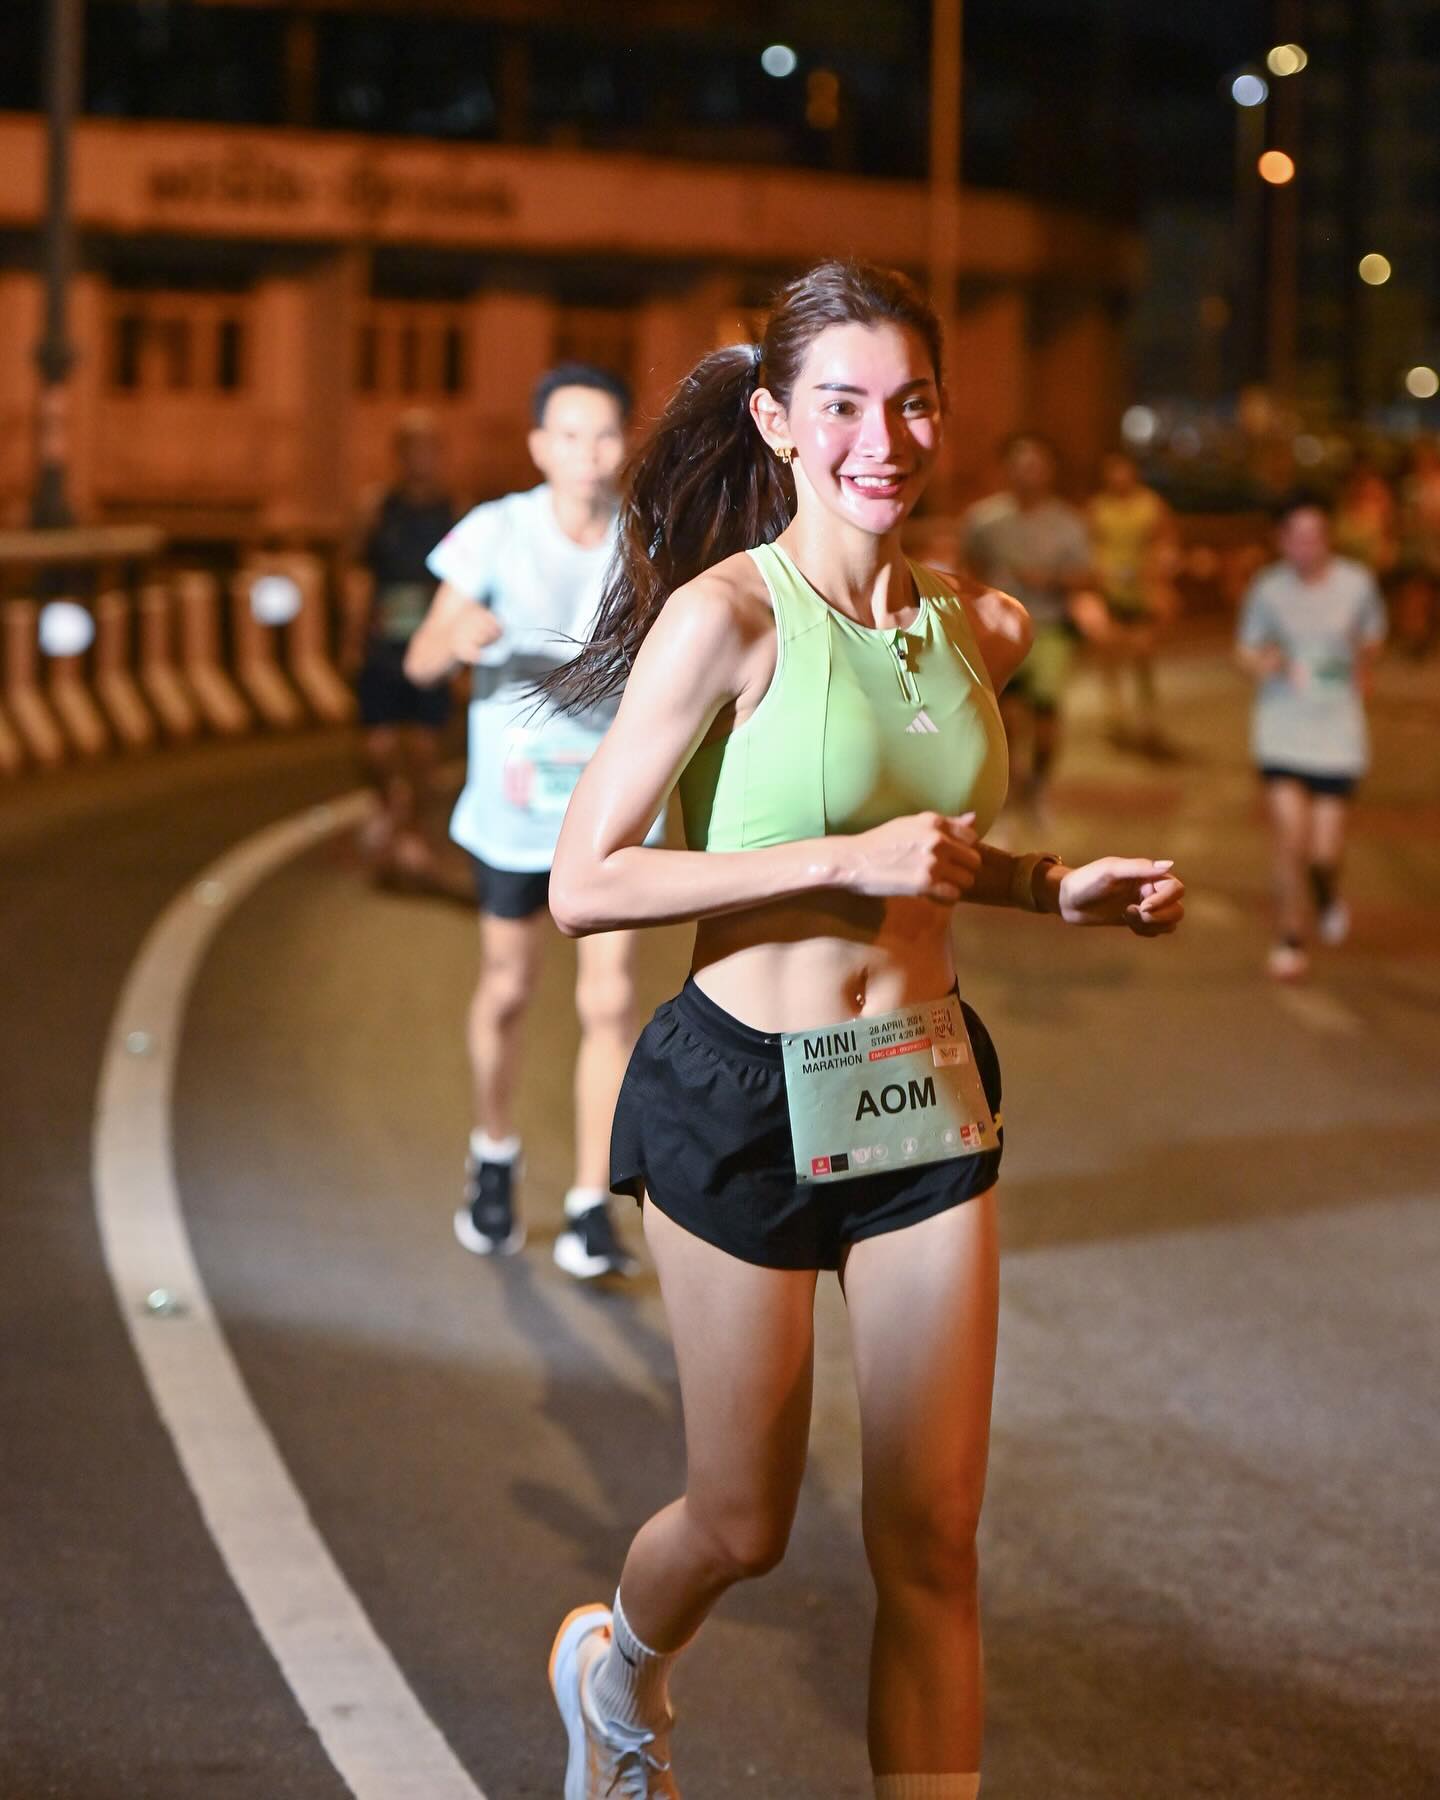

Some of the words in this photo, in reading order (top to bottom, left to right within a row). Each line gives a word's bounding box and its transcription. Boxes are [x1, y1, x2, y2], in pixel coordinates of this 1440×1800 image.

[869, 1025, 880, 1036] 28
[881, 1018, 903, 1032] APRIL
[871, 1034, 897, 1047] START
[899, 1031, 914, 1041] 4:20
[914, 1026, 926, 1035] AM
[803, 1030, 858, 1061] MINI
[802, 1053, 863, 1074] MARATHON
[855, 1076, 937, 1121] AOM
